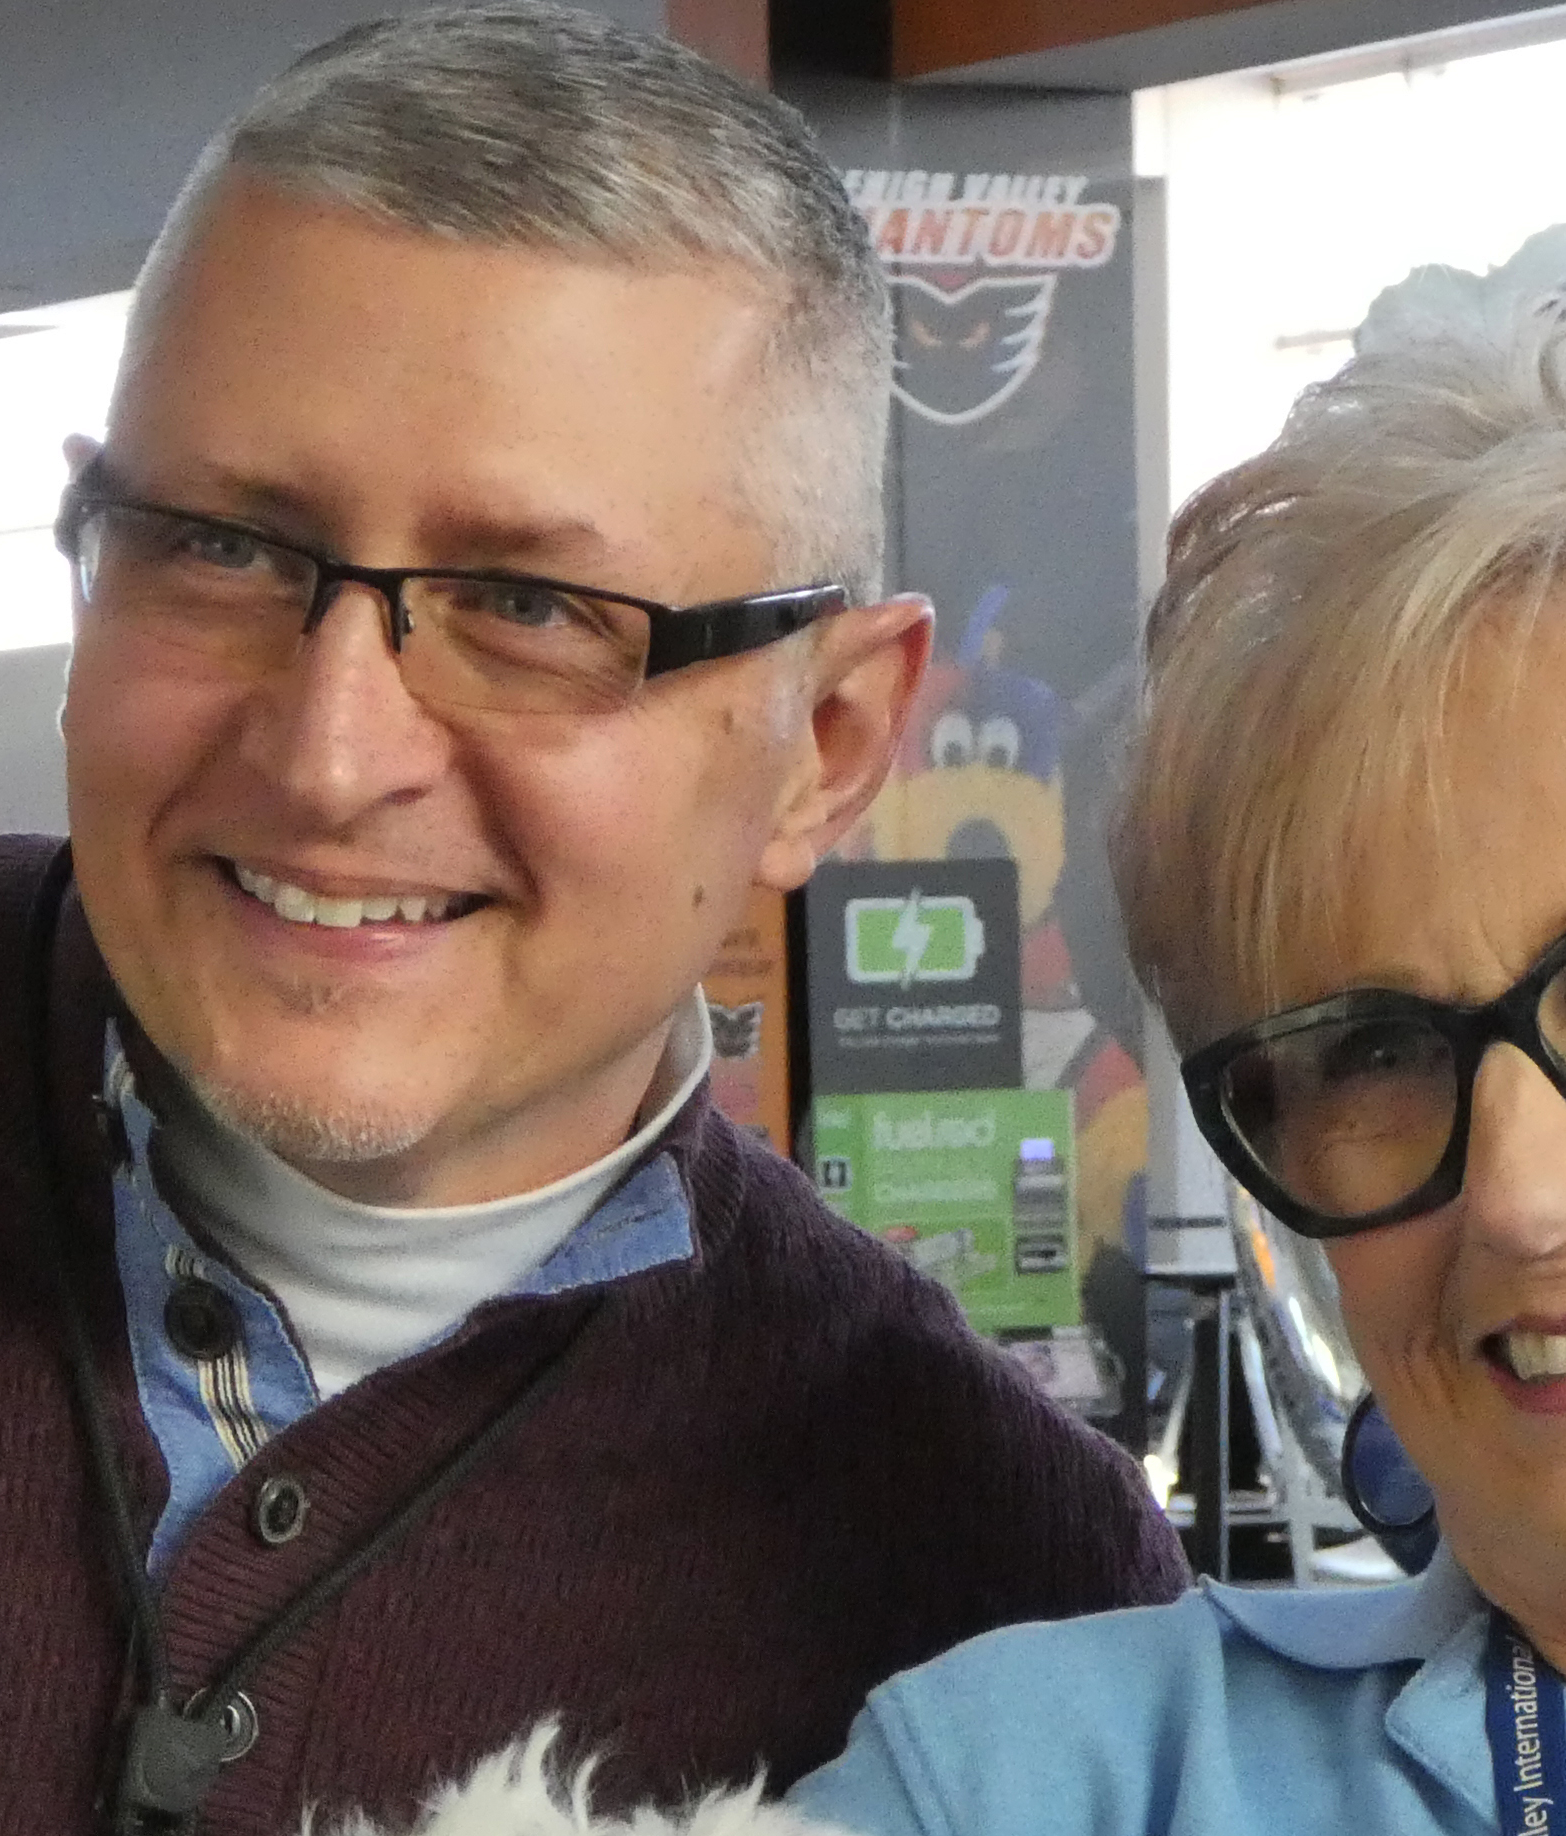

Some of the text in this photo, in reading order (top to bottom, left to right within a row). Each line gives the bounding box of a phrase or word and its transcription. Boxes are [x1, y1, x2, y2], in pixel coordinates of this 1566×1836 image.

[864, 205, 1114, 261] ANTOMS
[834, 1005, 1002, 1030] GET CHARGED
